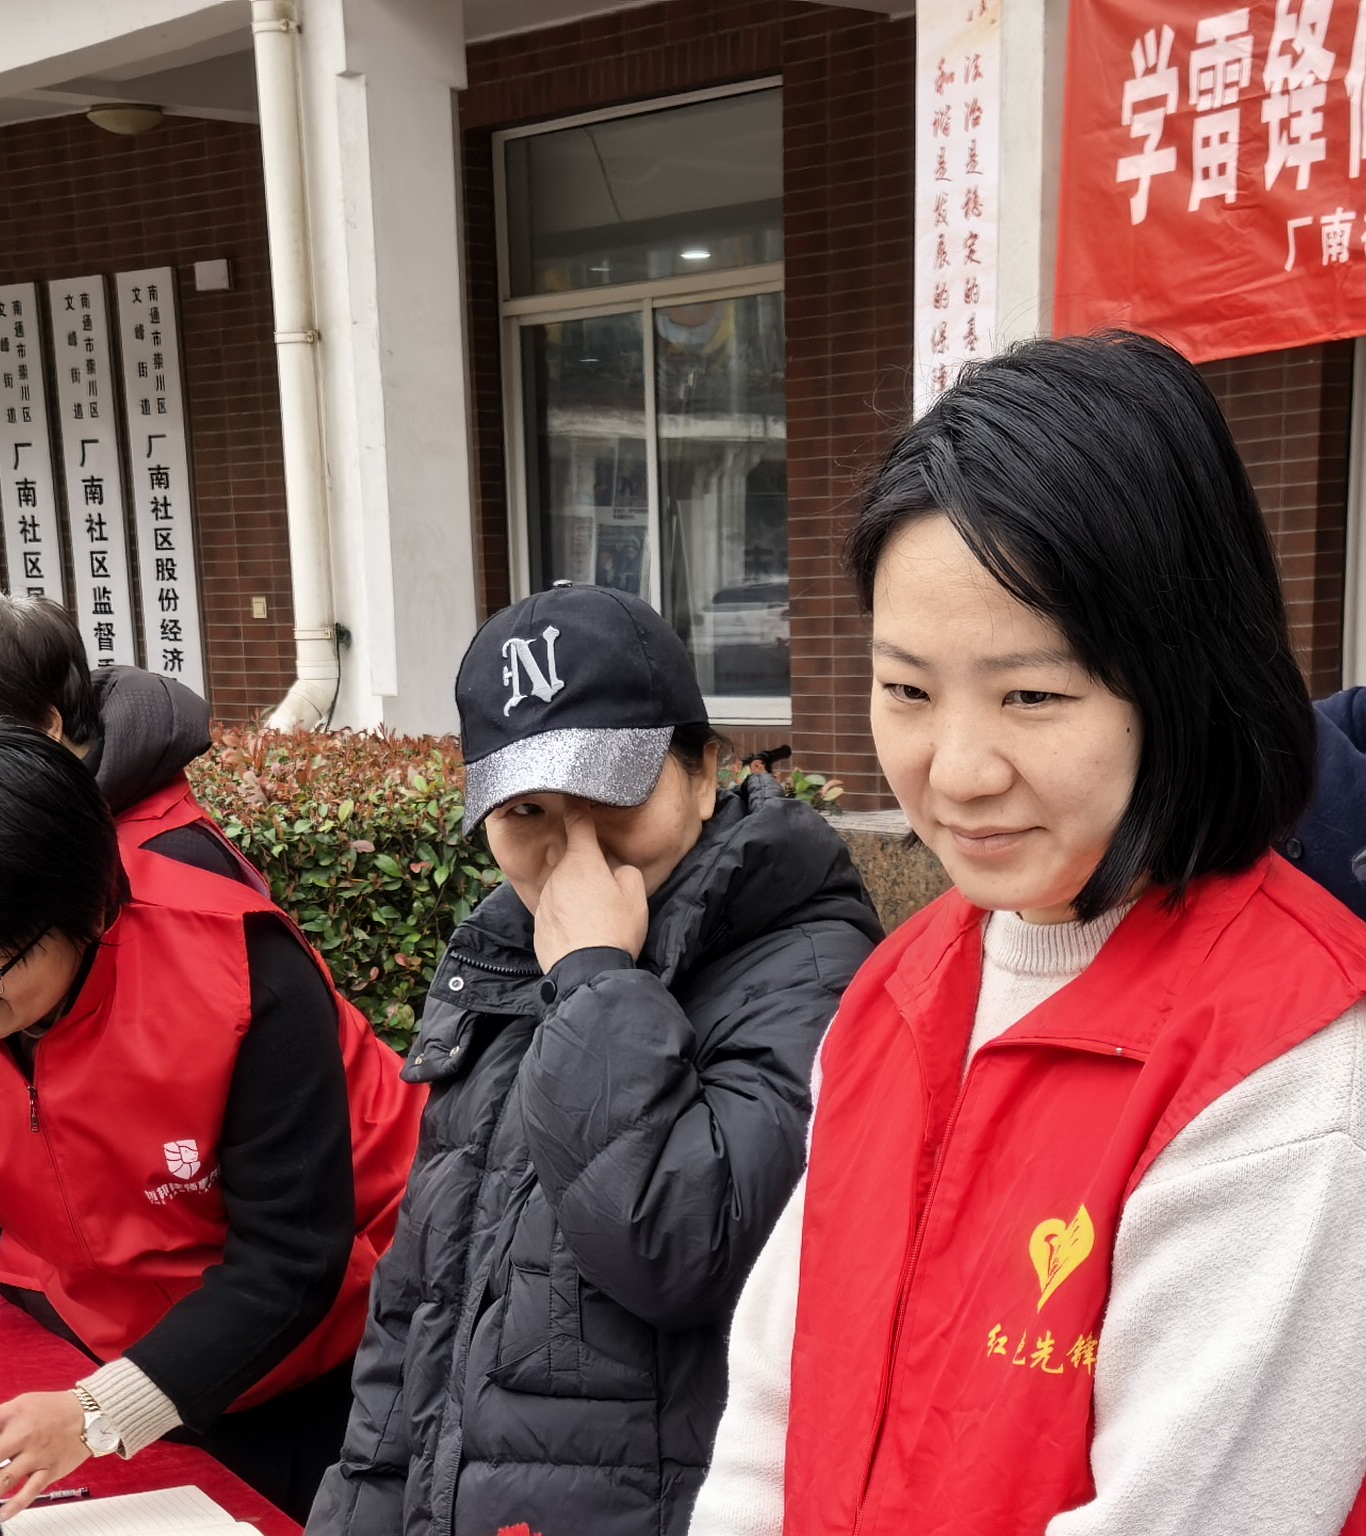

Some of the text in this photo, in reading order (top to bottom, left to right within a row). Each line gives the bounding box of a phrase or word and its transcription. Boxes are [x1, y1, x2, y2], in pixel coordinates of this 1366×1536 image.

[146, 433, 185, 673] 厂南社区股份经济
[501, 625, 565, 717] N
